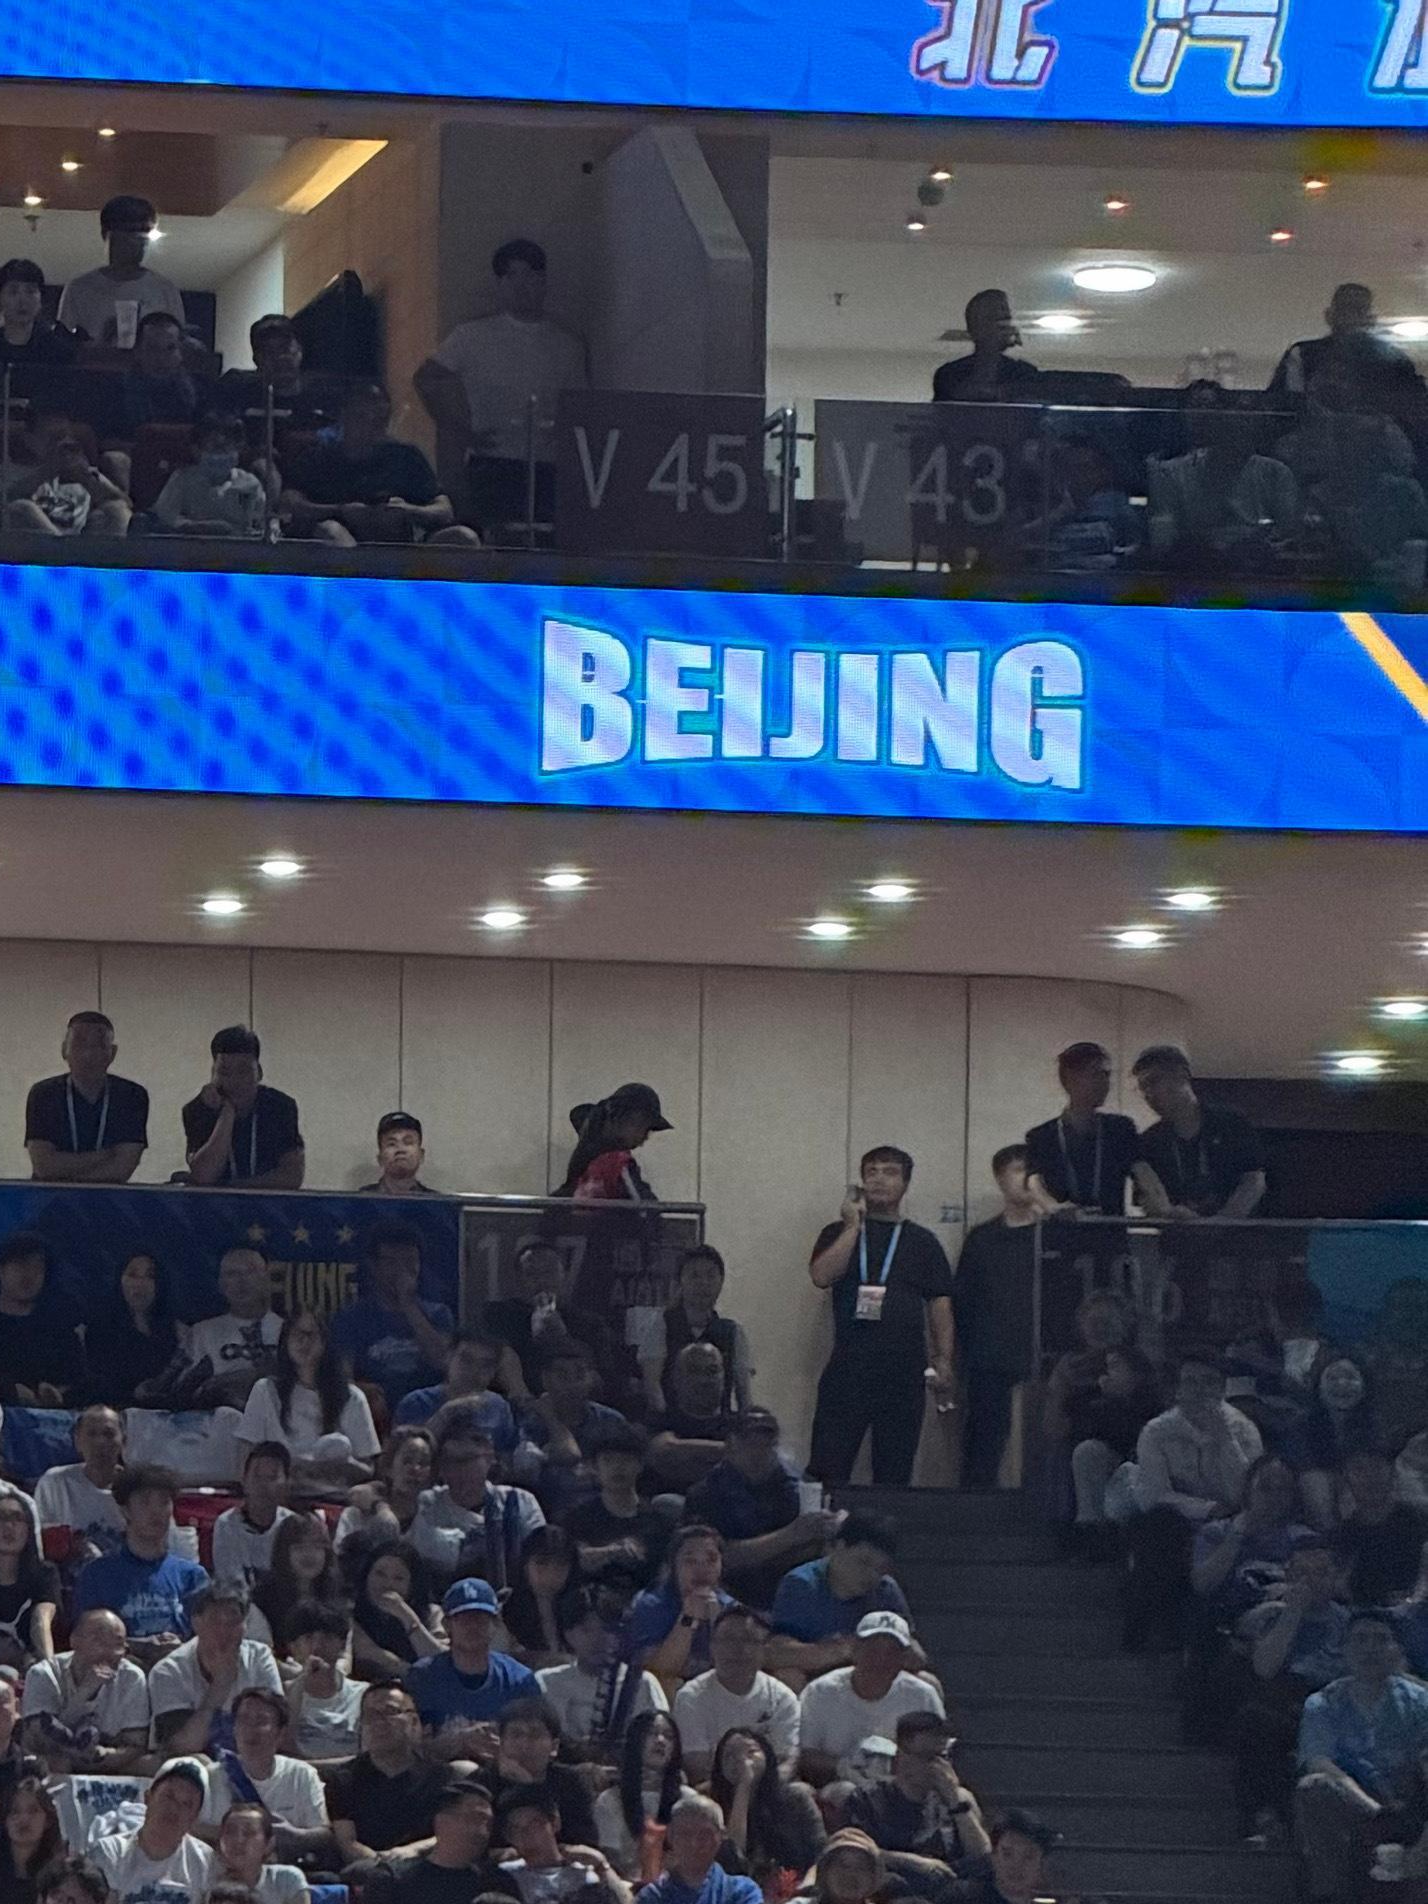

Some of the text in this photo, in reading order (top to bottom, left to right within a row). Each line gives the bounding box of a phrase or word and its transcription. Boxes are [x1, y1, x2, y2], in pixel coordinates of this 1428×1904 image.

[573, 425, 748, 514] V 45
[833, 440, 1007, 525] V 43
[539, 614, 1088, 795] BEIJING
